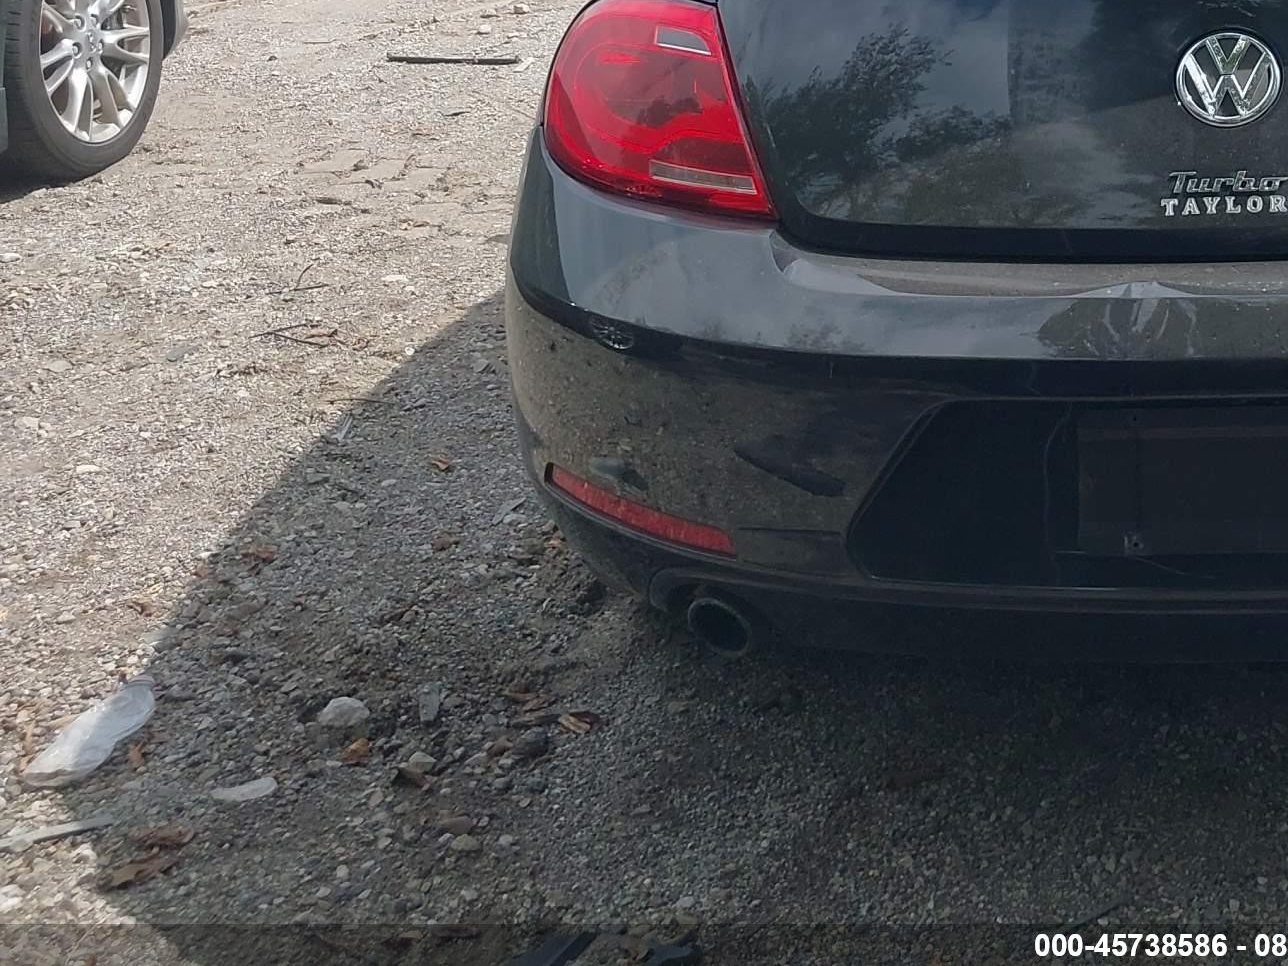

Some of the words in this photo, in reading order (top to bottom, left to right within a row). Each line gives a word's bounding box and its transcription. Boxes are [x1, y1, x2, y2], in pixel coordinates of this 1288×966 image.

[1178, 33, 1279, 125] VW
[1169, 170, 1288, 193] Turbo
[1160, 195, 1288, 216] TAYLOR
